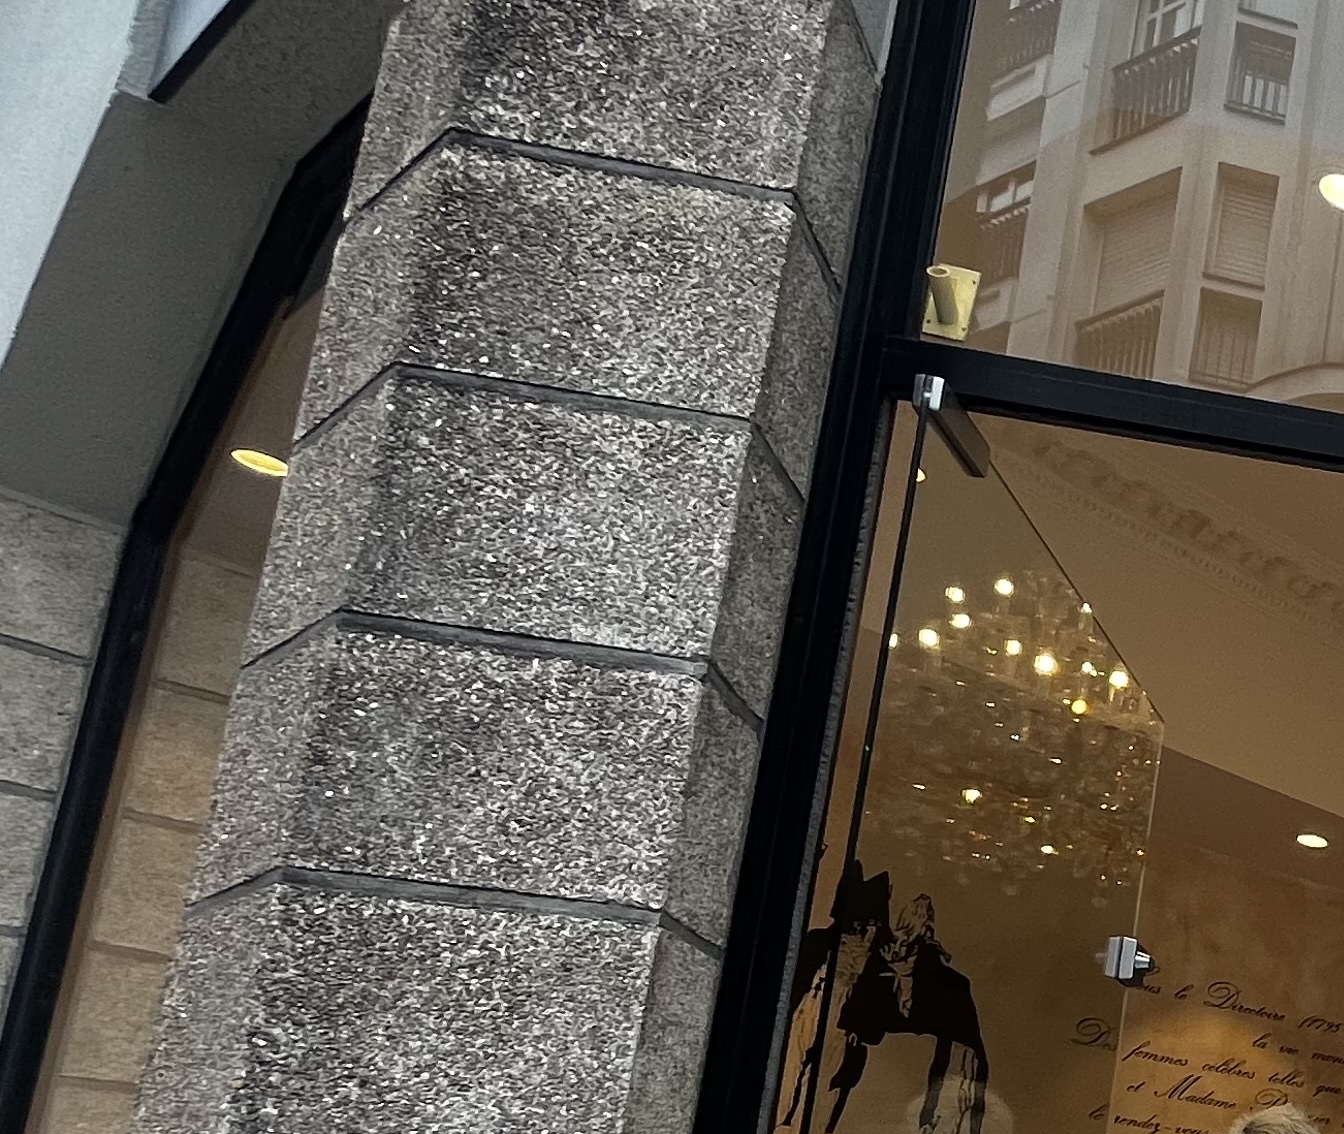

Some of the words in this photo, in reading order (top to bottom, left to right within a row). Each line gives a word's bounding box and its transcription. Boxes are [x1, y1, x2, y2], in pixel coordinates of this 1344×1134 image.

[1203, 981, 1286, 1022] Directoire
[1070, 1017, 1118, 1053] Des
[1121, 1040, 1189, 1067] femmes
[1268, 1070, 1305, 1089] telles
[1312, 1084, 1342, 1098] que
[1252, 1032, 1272, 1050] la
[1126, 1080, 1146, 1094] et
[1153, 1073, 1237, 1110] Madame
